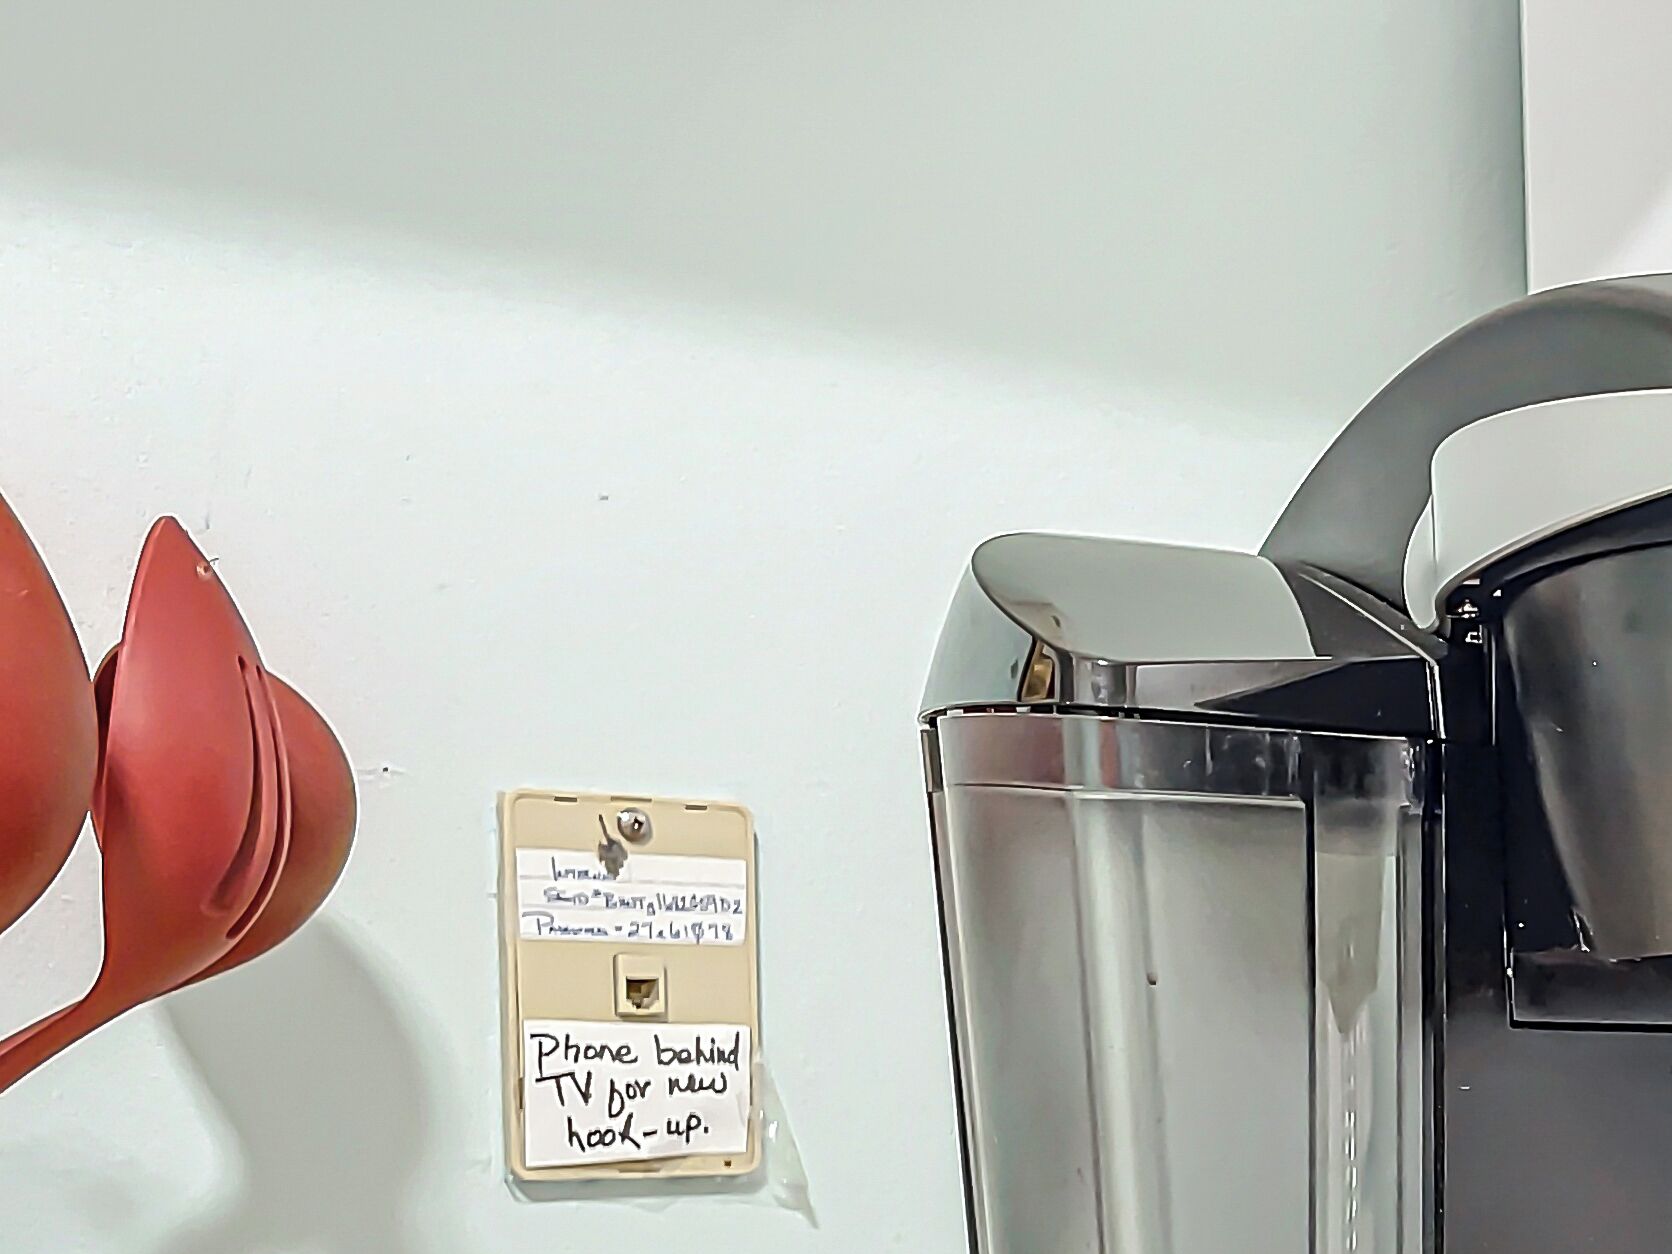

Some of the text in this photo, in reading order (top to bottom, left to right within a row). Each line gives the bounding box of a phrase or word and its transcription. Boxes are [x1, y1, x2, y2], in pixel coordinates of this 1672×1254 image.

[530, 1031, 740, 1077] Phone behind
[535, 1071, 728, 1118] TV for new
